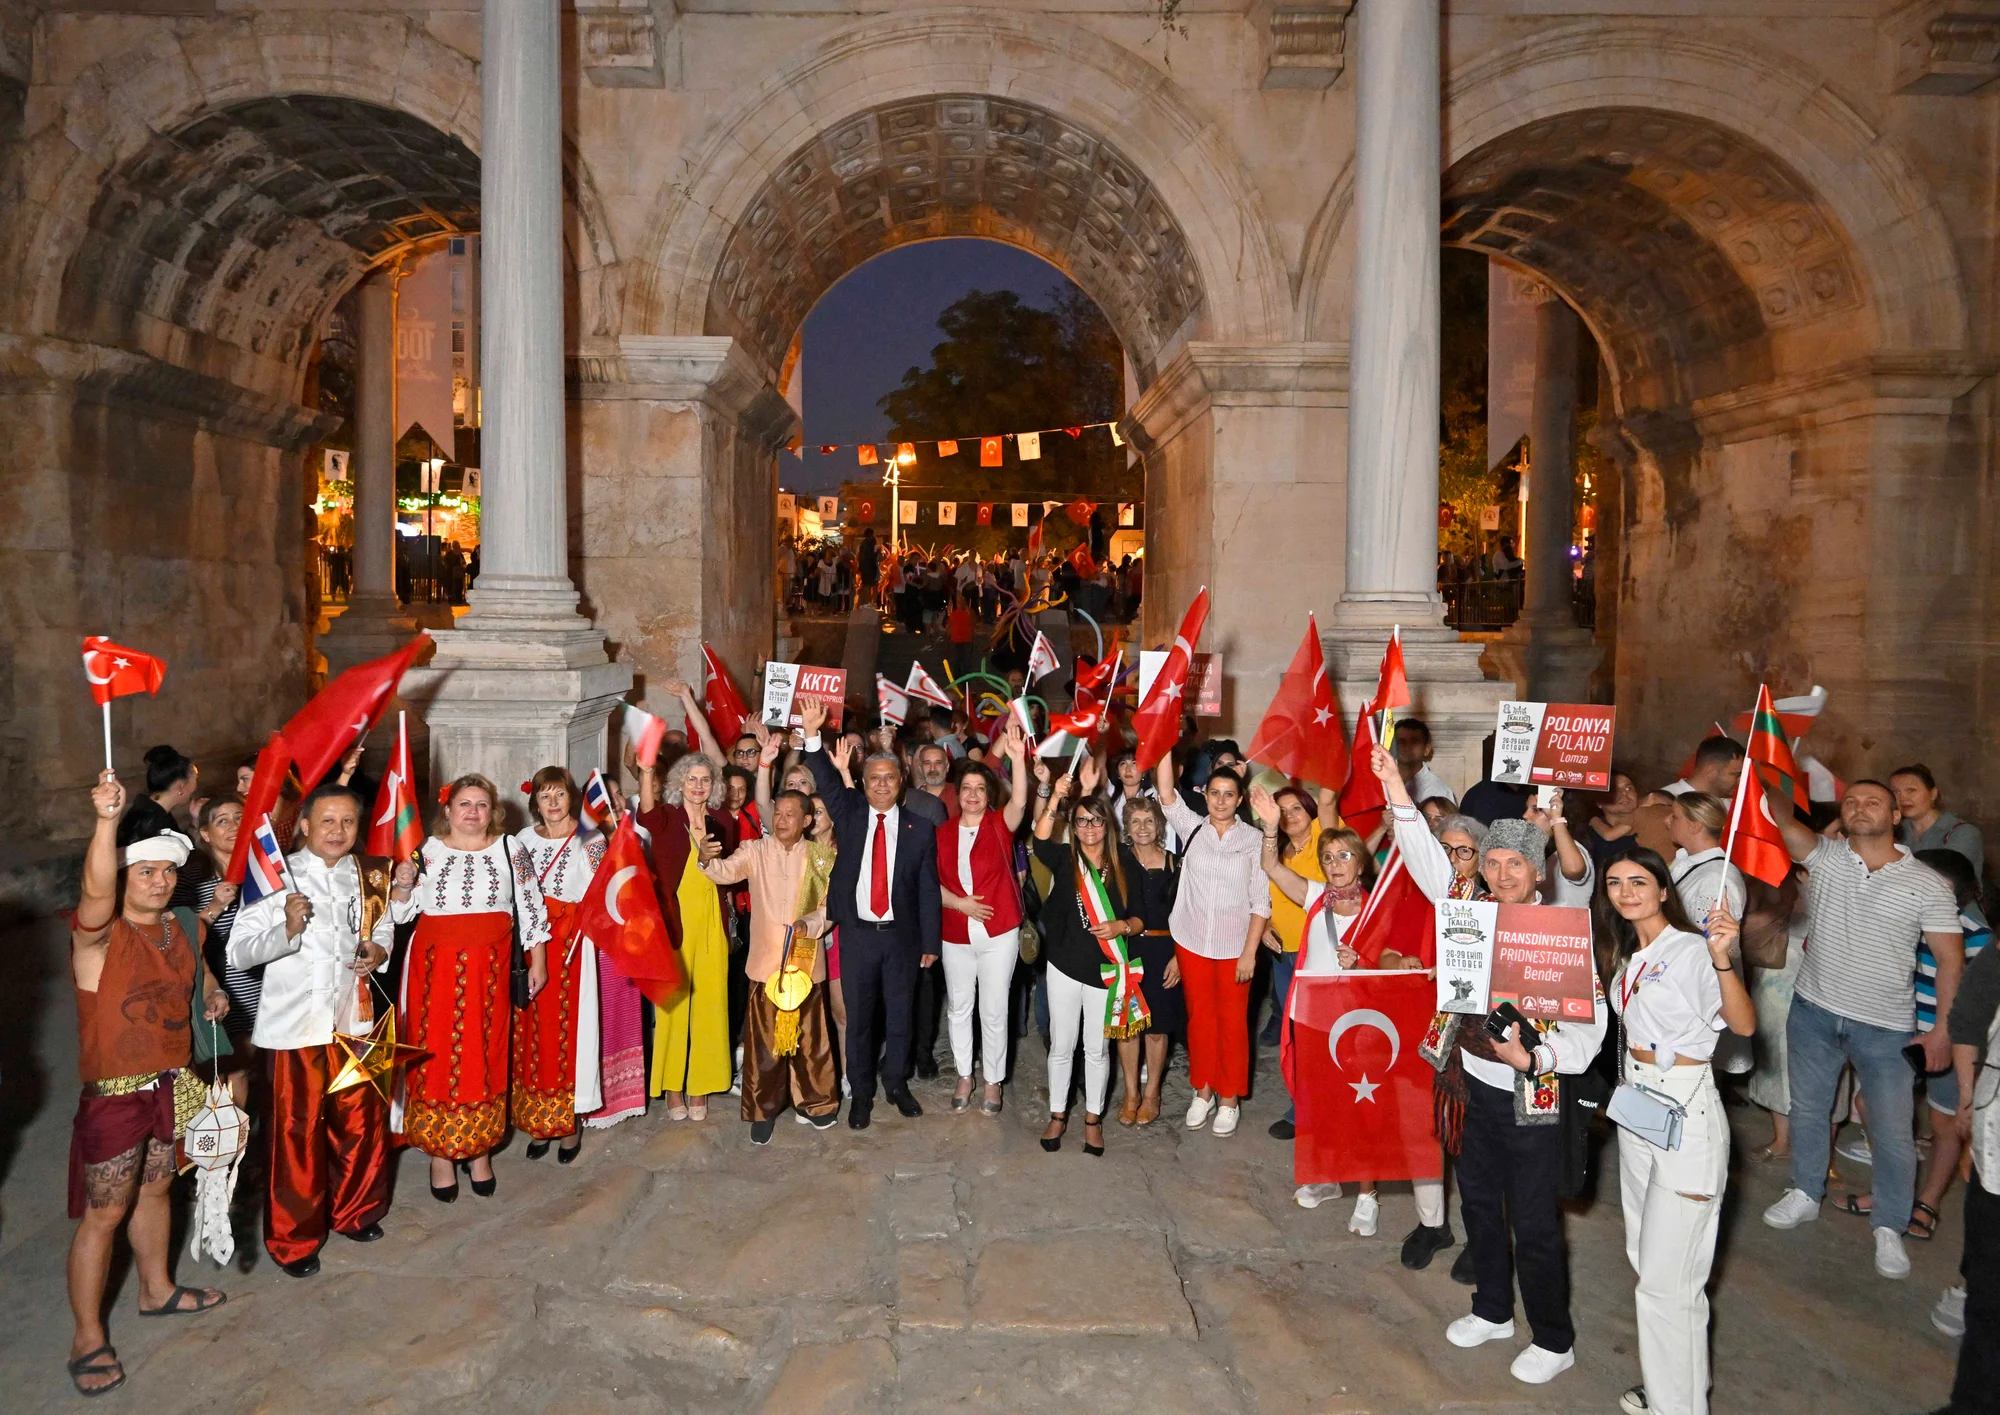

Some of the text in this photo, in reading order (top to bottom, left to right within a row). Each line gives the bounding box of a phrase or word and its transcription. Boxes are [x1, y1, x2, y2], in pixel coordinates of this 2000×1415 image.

[800, 672, 841, 693] KKTC
[822, 694, 844, 704] CYPRUS
[1544, 716, 1611, 735] POLONYA
[1547, 734, 1605, 752] POLAND
[1560, 752, 1589, 764] Lomza
[1497, 931, 1588, 949] TRANSDİNYESTER
[1446, 949, 1465, 959] 26-29
[1499, 947, 1585, 967] PRIDNESTROVIA
[1446, 958, 1483, 970] OCTOBER
[1524, 966, 1564, 982] Bender
